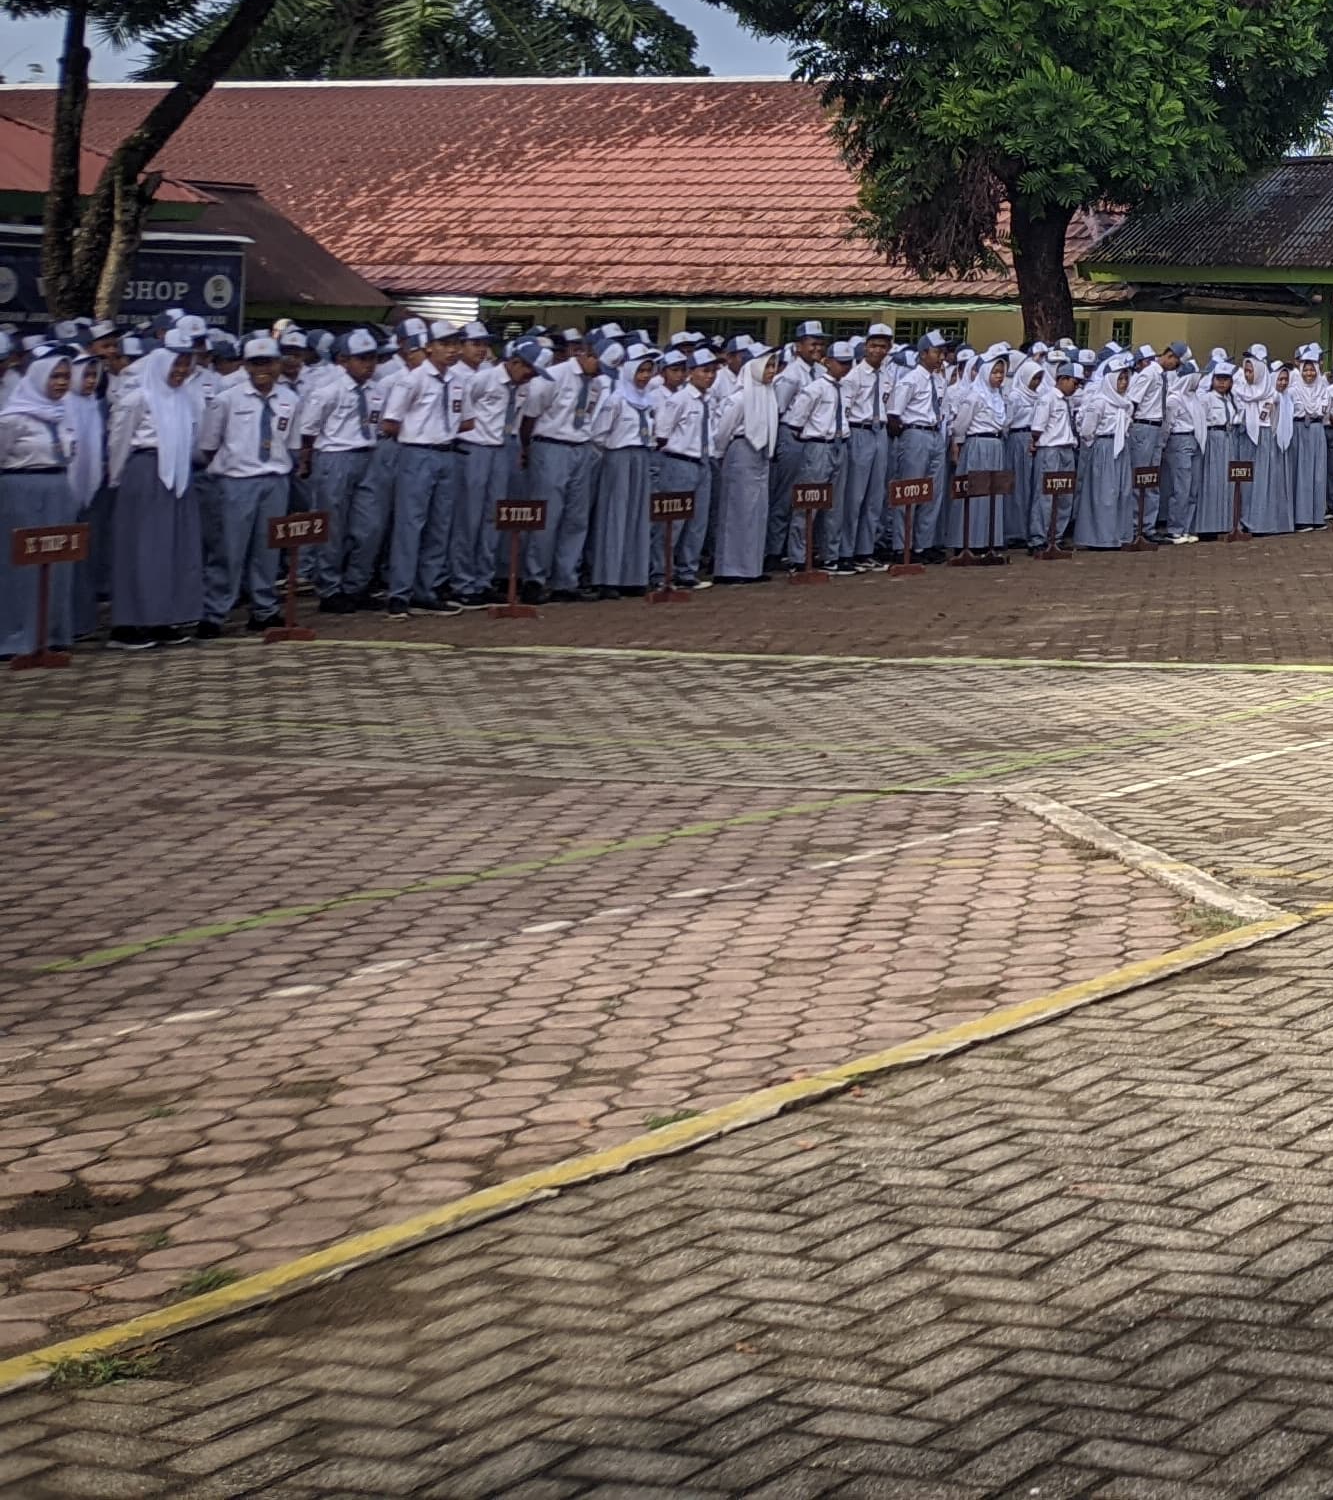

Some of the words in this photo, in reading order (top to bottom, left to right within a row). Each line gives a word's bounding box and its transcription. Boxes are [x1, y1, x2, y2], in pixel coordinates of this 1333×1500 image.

[796, 490, 803, 501] X
[804, 490, 820, 501] OTO
[895, 487, 901, 498] X
[904, 485, 920, 497] OTO
[922, 484, 929, 495] 2
[685, 498, 692, 511] 2
[313, 519, 323, 534] 2
